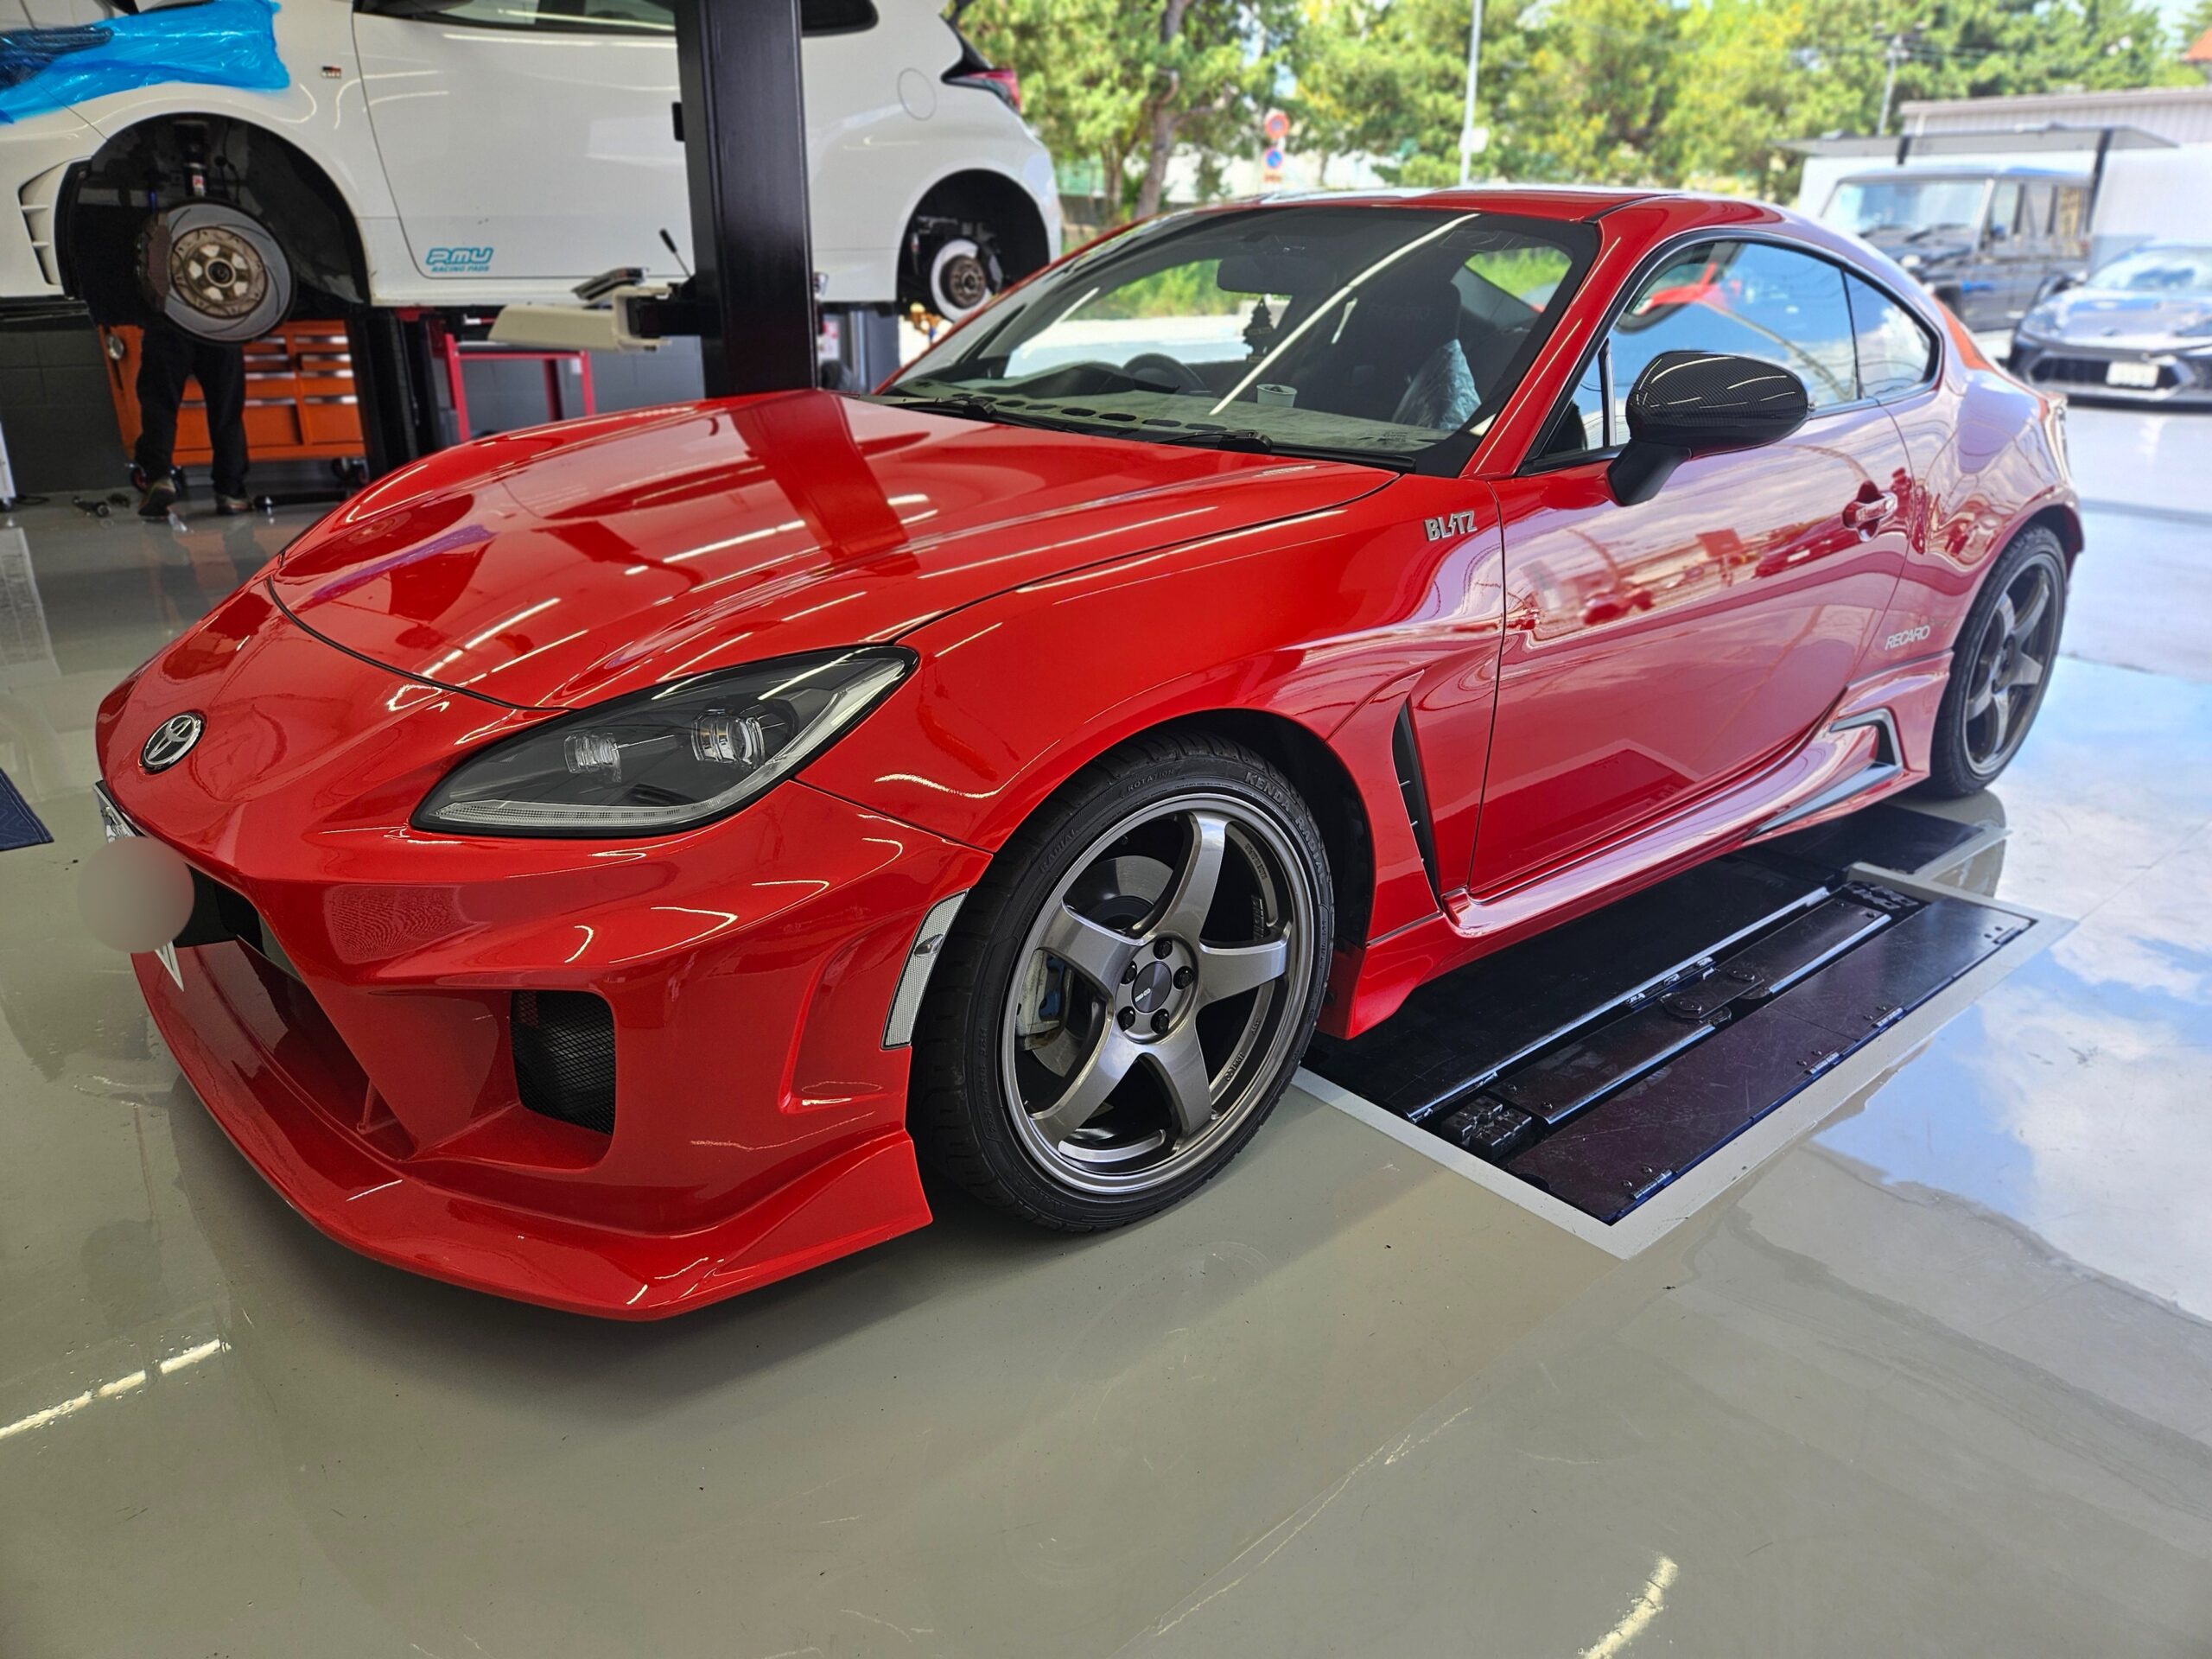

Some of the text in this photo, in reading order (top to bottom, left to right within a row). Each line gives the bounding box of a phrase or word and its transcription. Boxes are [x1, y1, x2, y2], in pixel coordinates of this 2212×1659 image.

[1424, 510, 1478, 542] BLITZ
[1885, 625, 1930, 651] RECARO
[1128, 768, 1174, 792] ROTATION
[1245, 772, 1292, 811] KENDA
[1296, 815, 1325, 885] RADIAL
